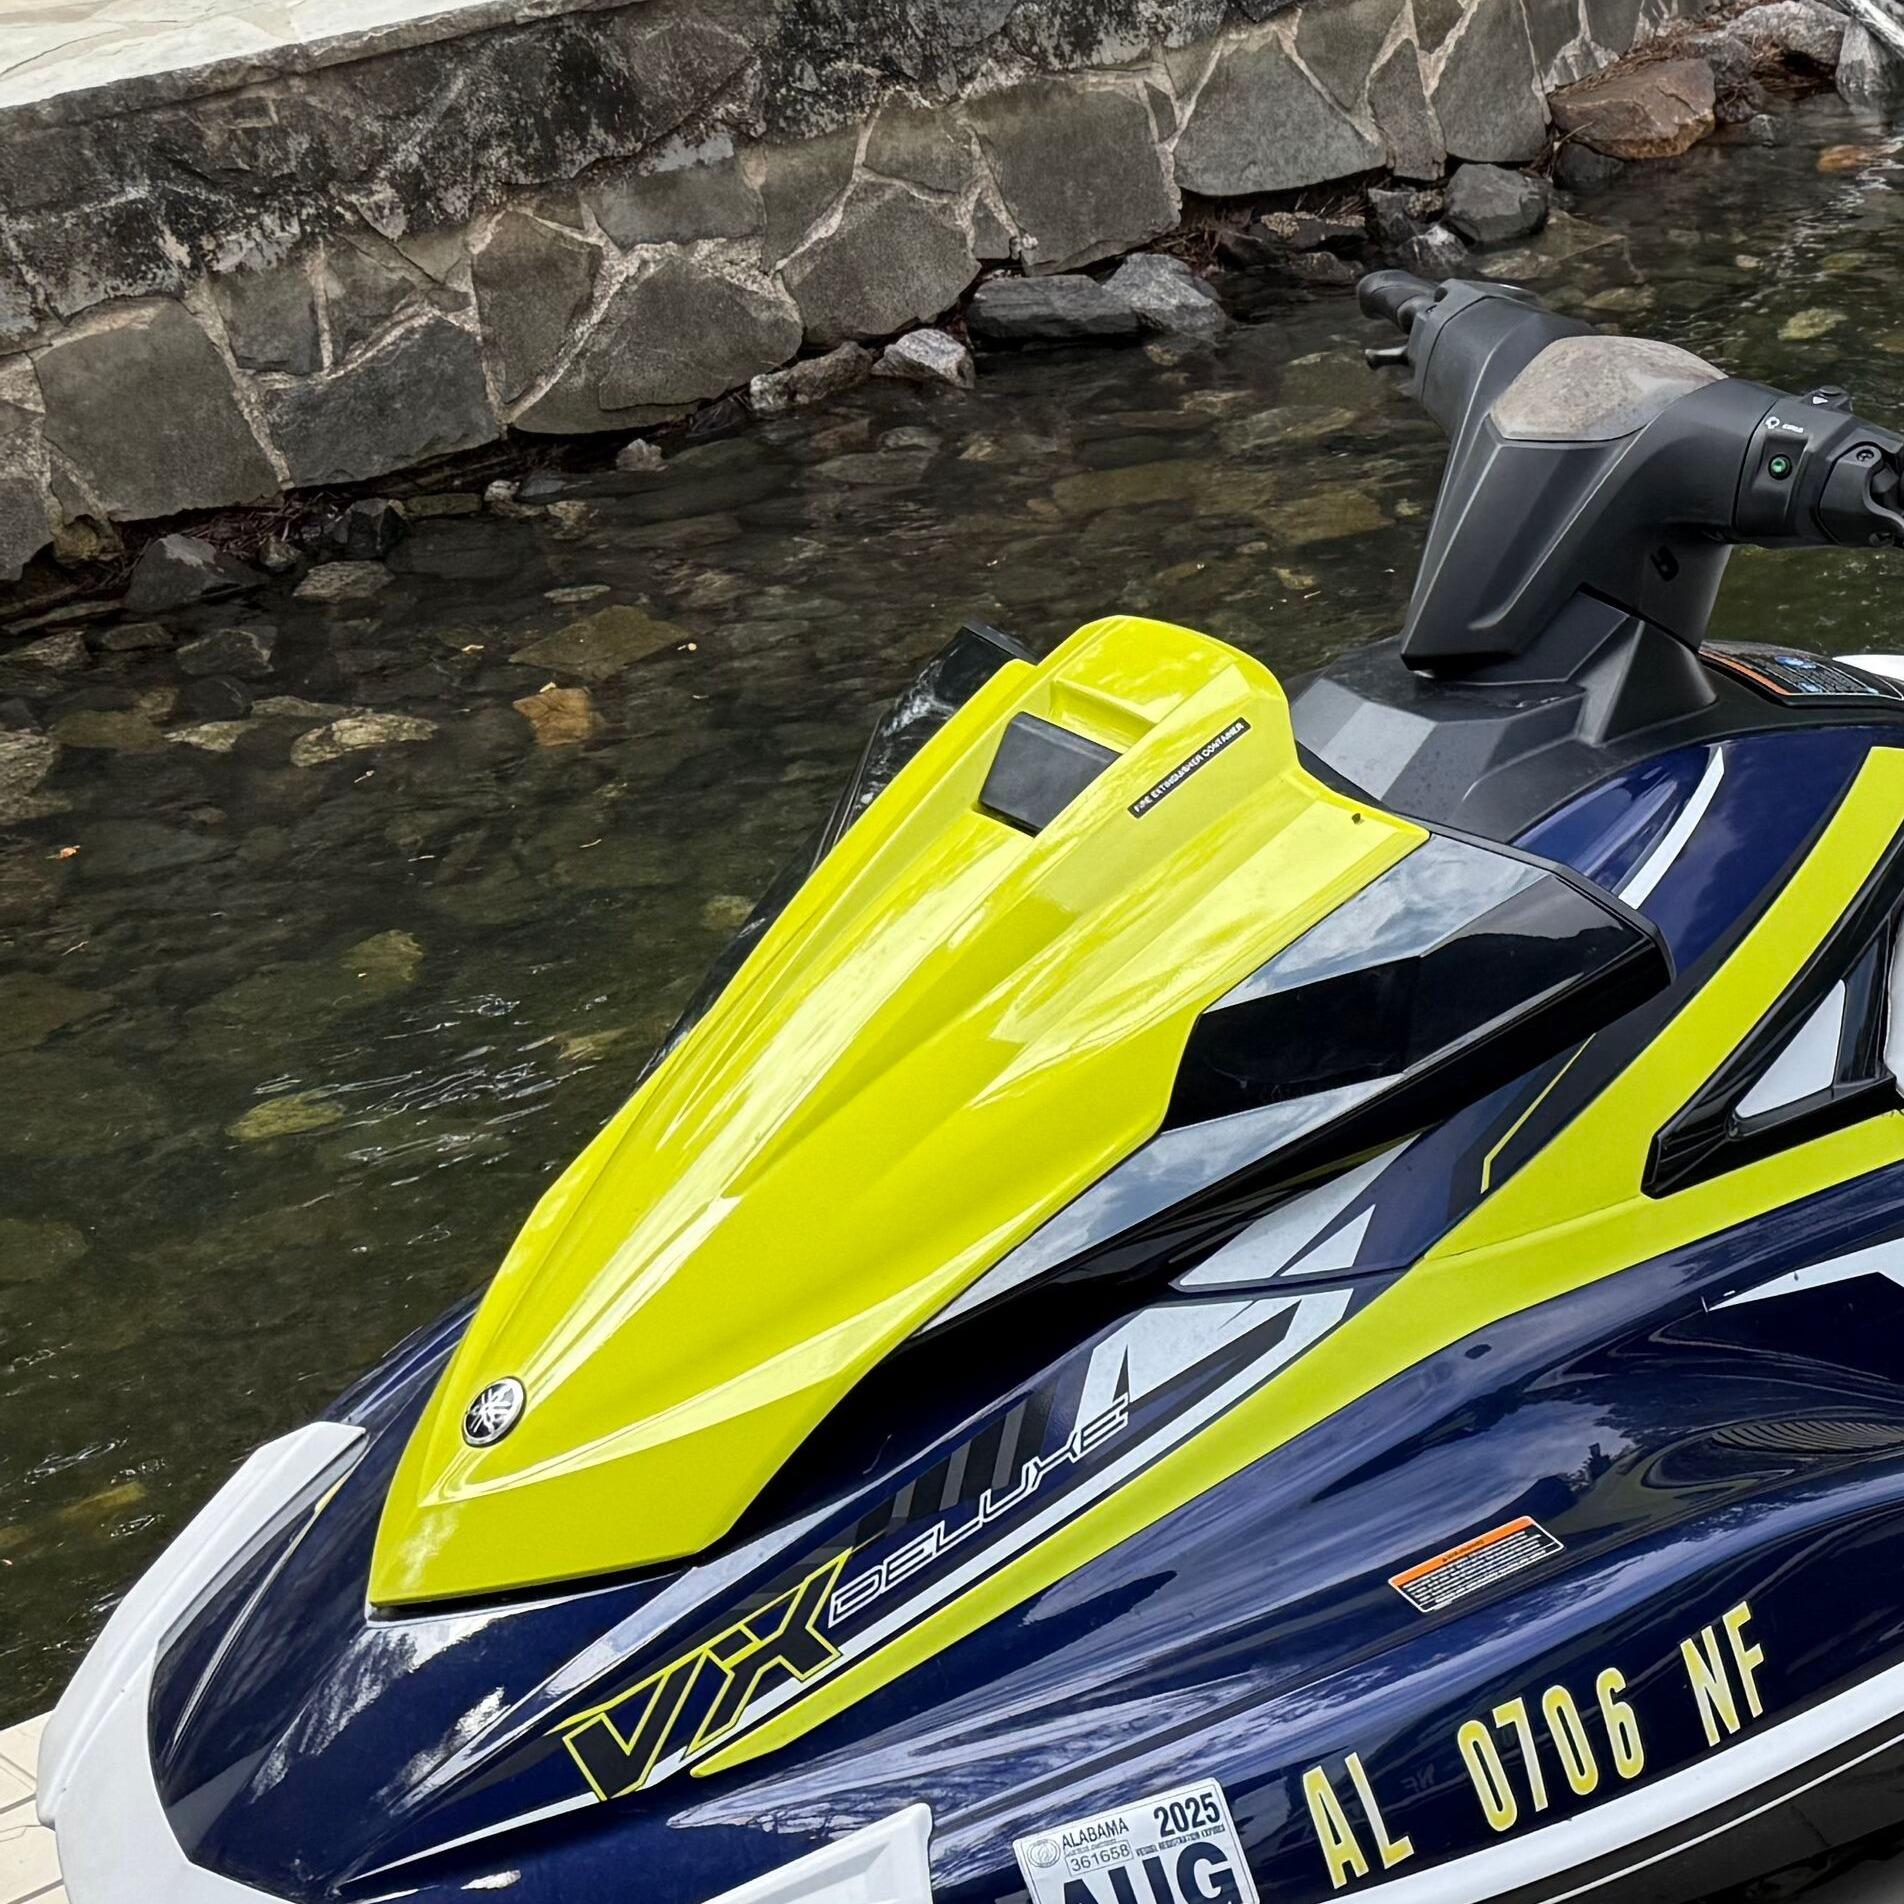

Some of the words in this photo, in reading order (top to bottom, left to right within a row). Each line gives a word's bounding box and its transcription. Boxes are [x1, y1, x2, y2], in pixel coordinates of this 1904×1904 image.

[561, 1546, 853, 1801] VX
[828, 1394, 1128, 1628] DELUXE
[1303, 1752, 1414, 1889] AL
[1458, 1668, 1644, 1831] 0706
[1680, 1601, 1764, 1746] NF
[1062, 1817, 1129, 1850] ALABAMA
[1154, 1792, 1220, 1838] 2025
[1071, 1844, 1131, 1871] 361658
